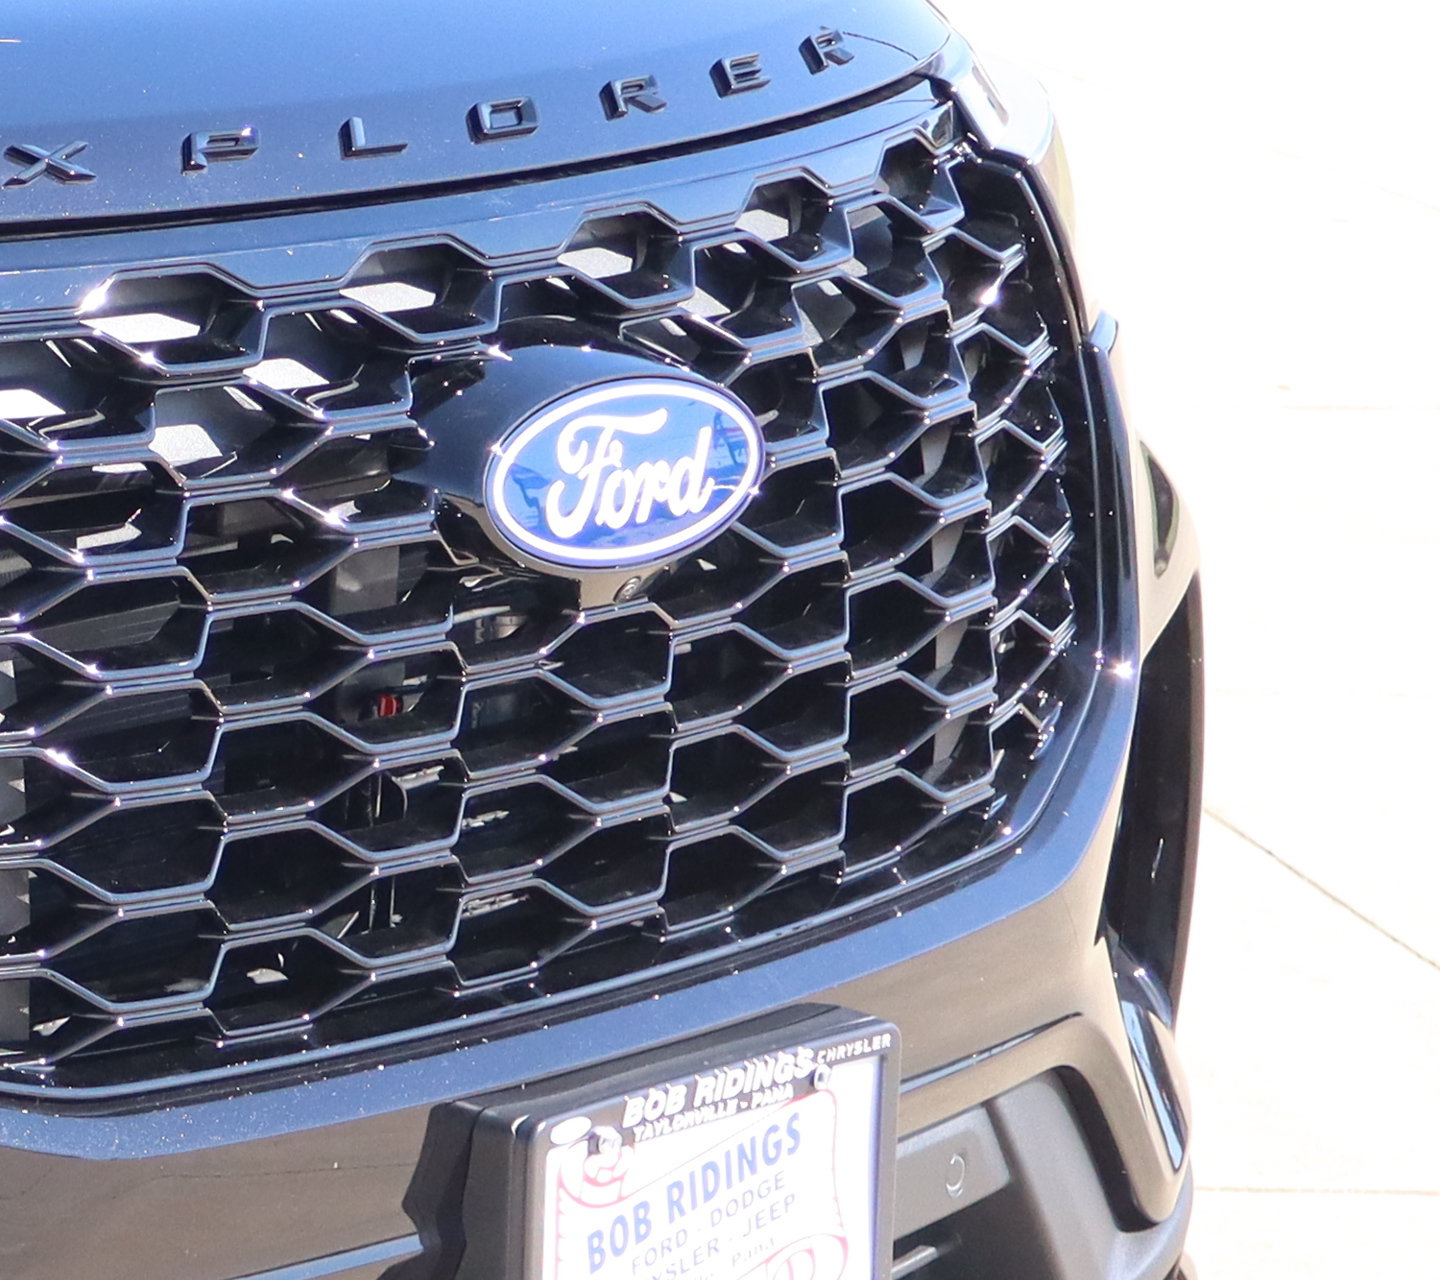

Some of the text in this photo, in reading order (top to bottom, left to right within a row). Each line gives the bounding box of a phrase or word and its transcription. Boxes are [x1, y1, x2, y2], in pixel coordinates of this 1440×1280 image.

[546, 407, 716, 539] Ford
[623, 1046, 818, 1129] BOB RIDINGS
[815, 1033, 892, 1065] CHRYSLER
[751, 1082, 795, 1110] PANA
[586, 1112, 801, 1275] BOB RIDINGS
[630, 1170, 786, 1276] FORD DODGE
[741, 1193, 797, 1238] JEEP
